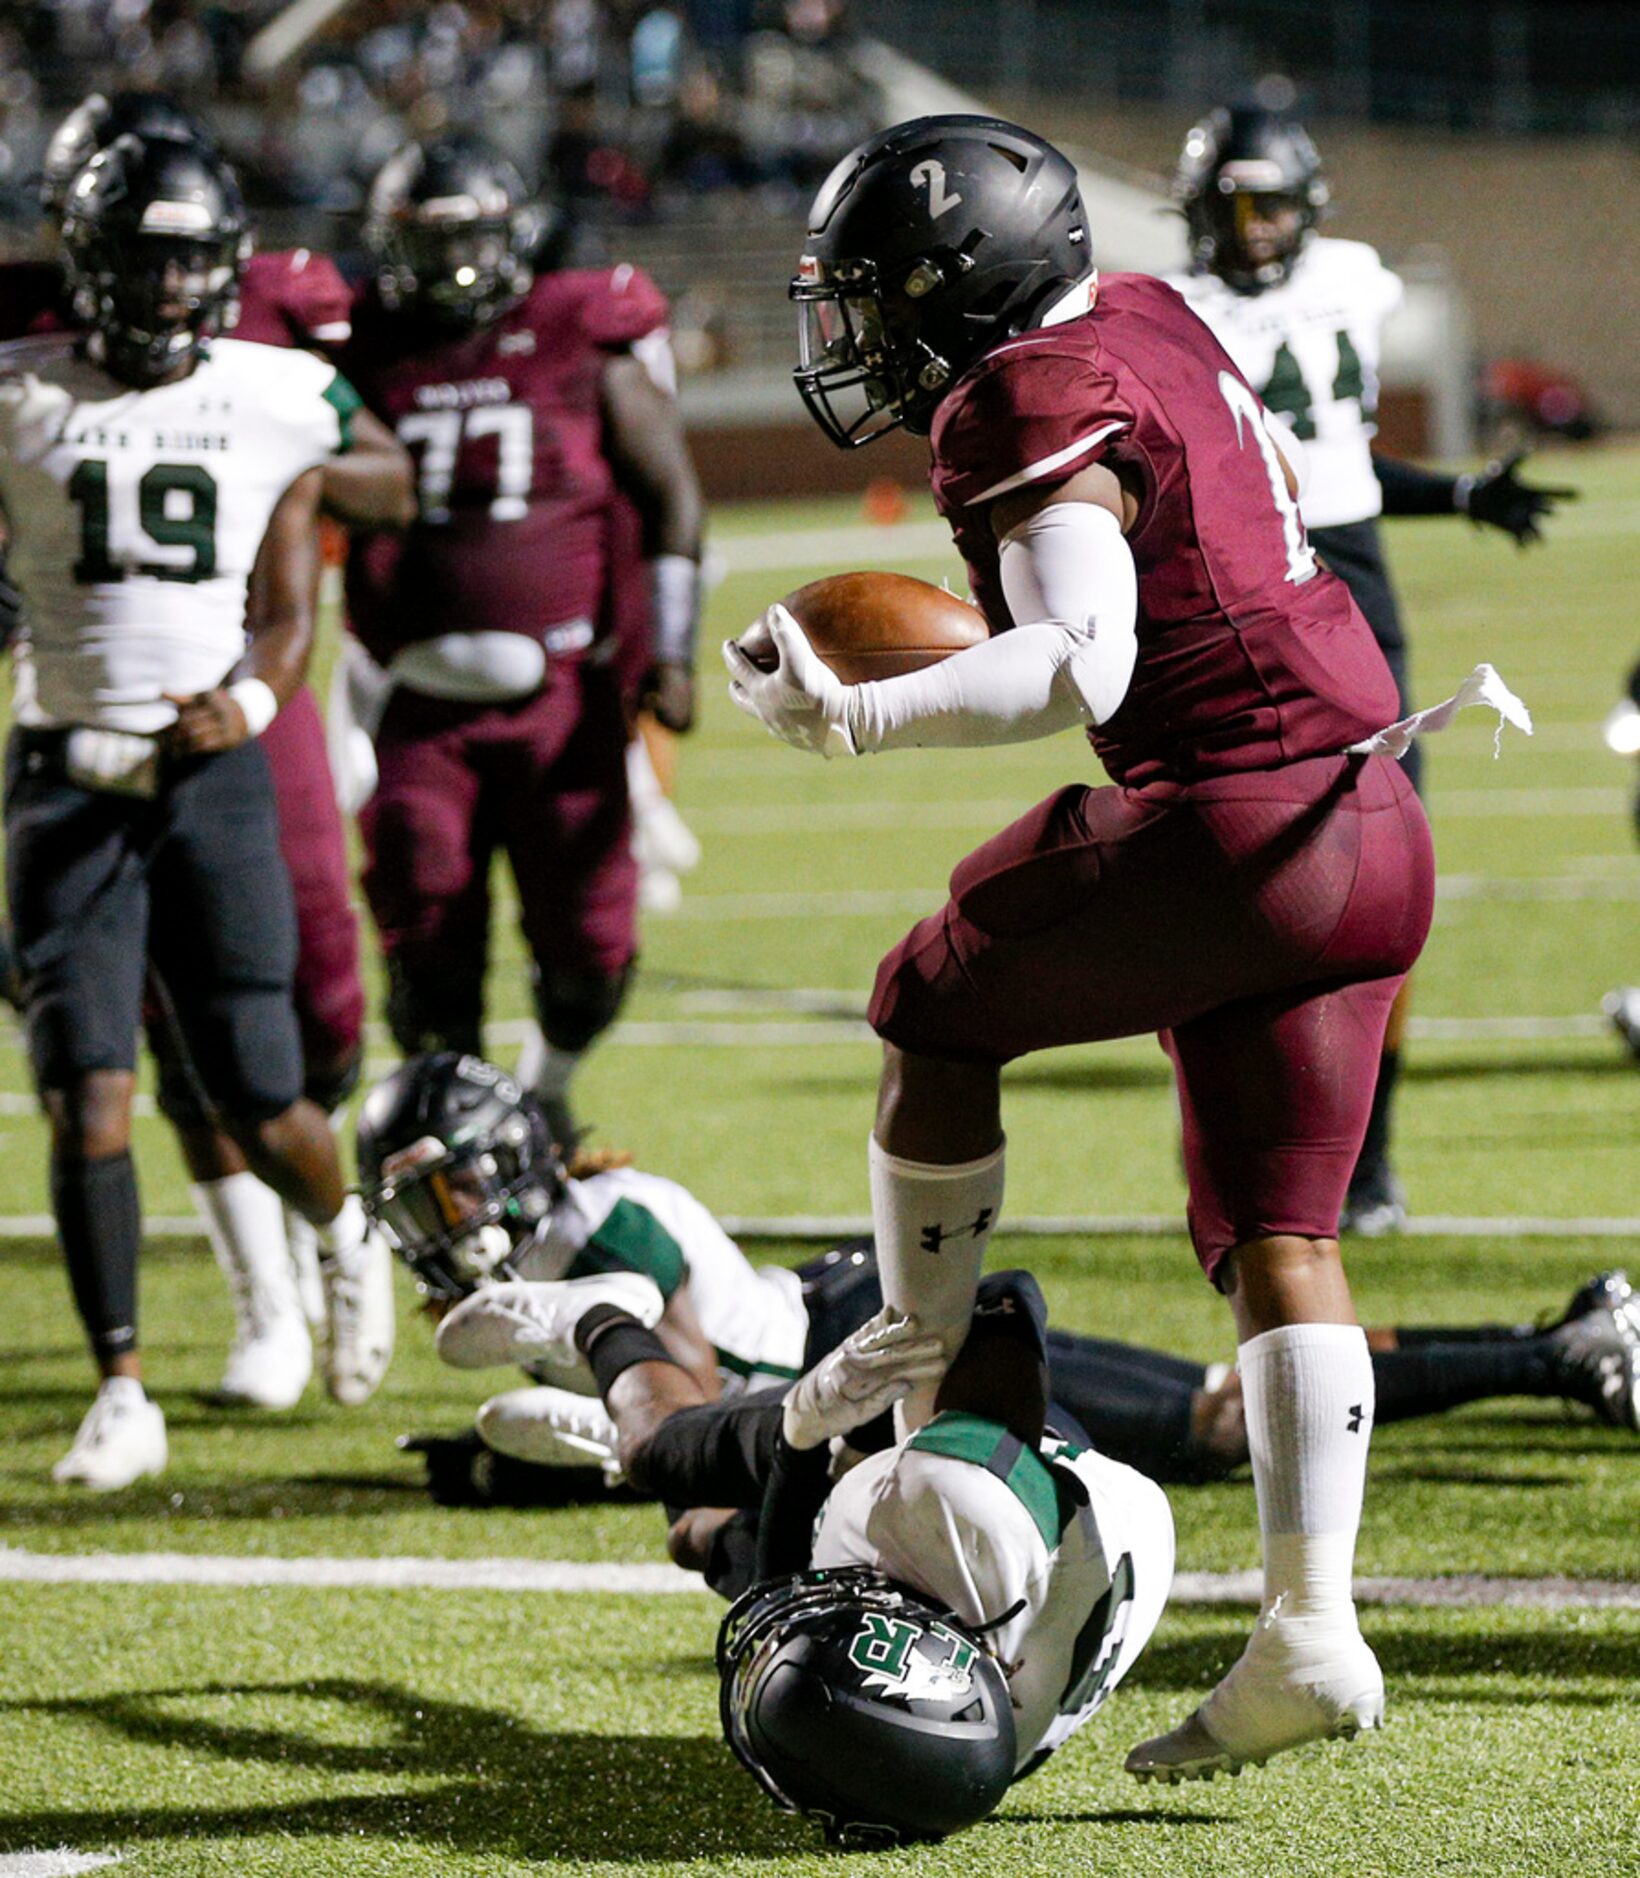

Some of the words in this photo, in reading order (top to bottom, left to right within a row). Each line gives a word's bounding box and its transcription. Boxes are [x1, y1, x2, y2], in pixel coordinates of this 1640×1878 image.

[910, 159, 963, 219] 2
[70, 458, 217, 584] 19
[396, 403, 533, 523] 77
